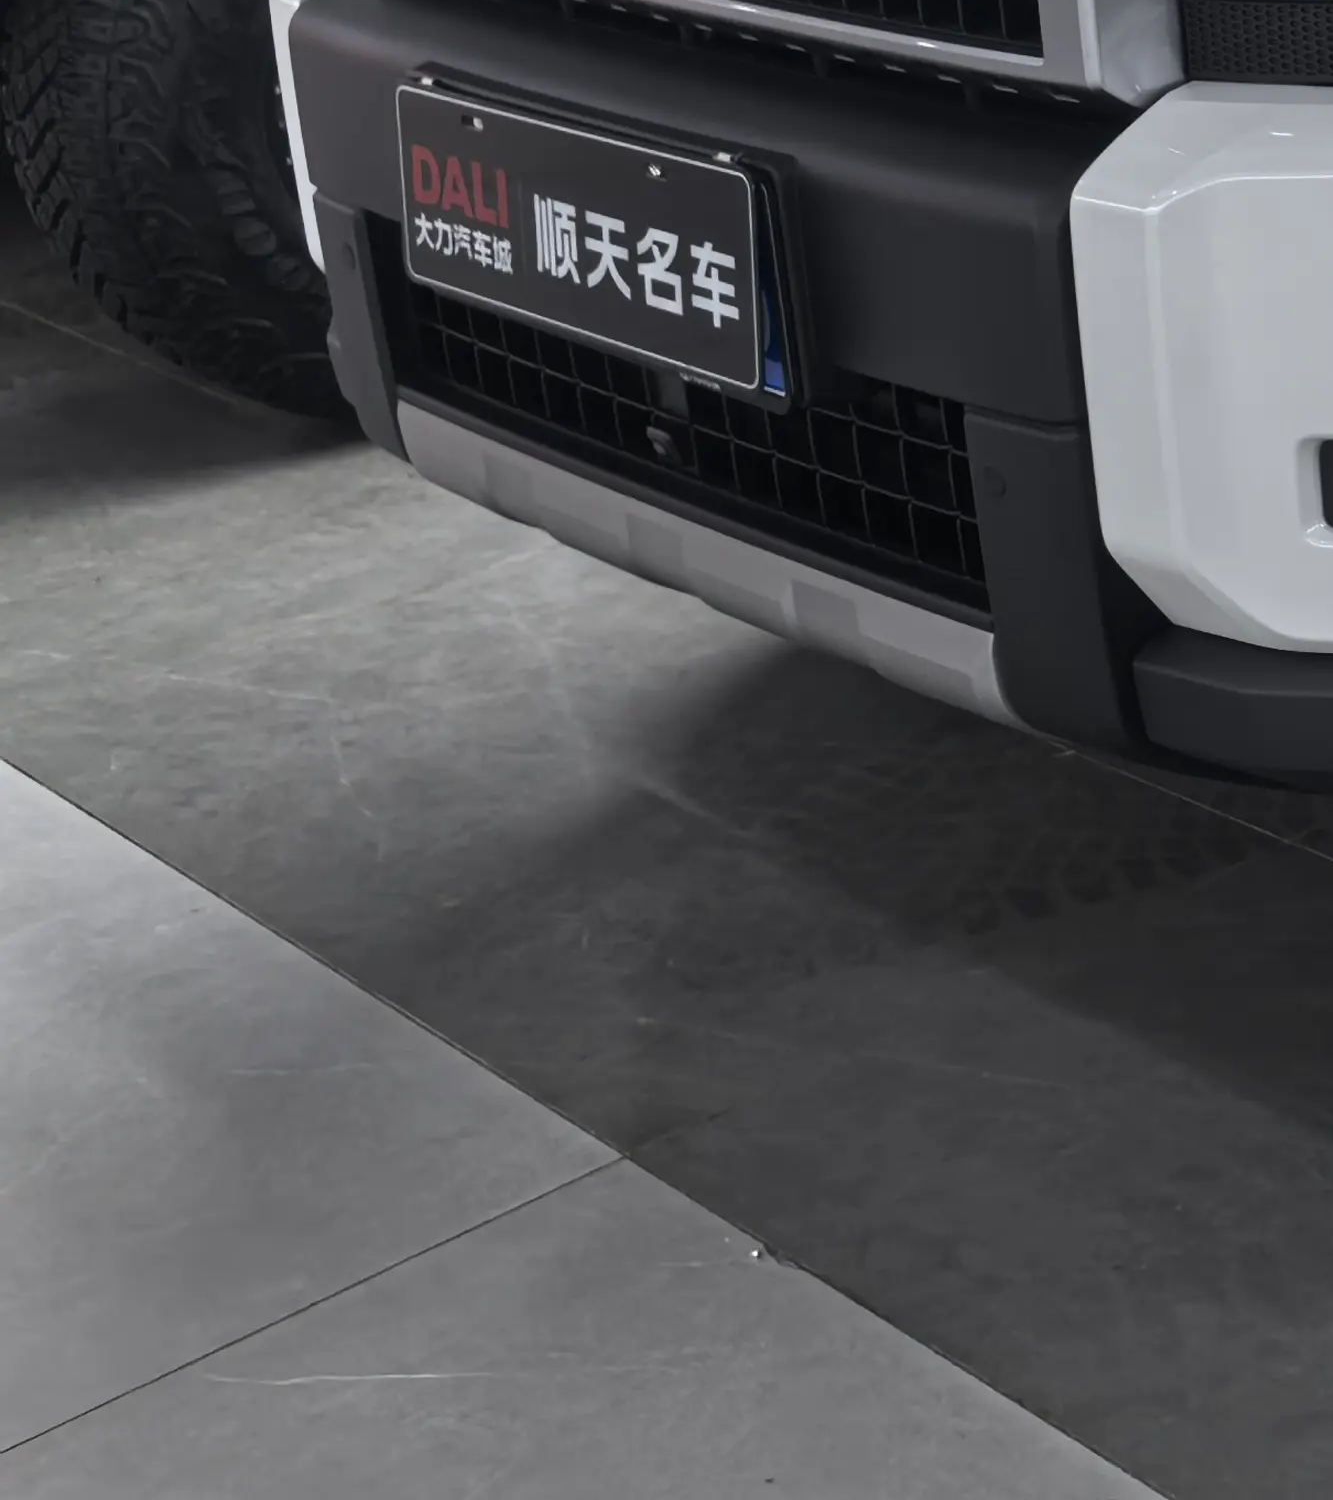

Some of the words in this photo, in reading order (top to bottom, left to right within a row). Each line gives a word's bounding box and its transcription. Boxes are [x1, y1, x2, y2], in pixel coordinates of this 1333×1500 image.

[411, 144, 509, 229] DALI
[414, 211, 514, 275] 大力汽车城
[533, 192, 740, 329] 顺天名车
